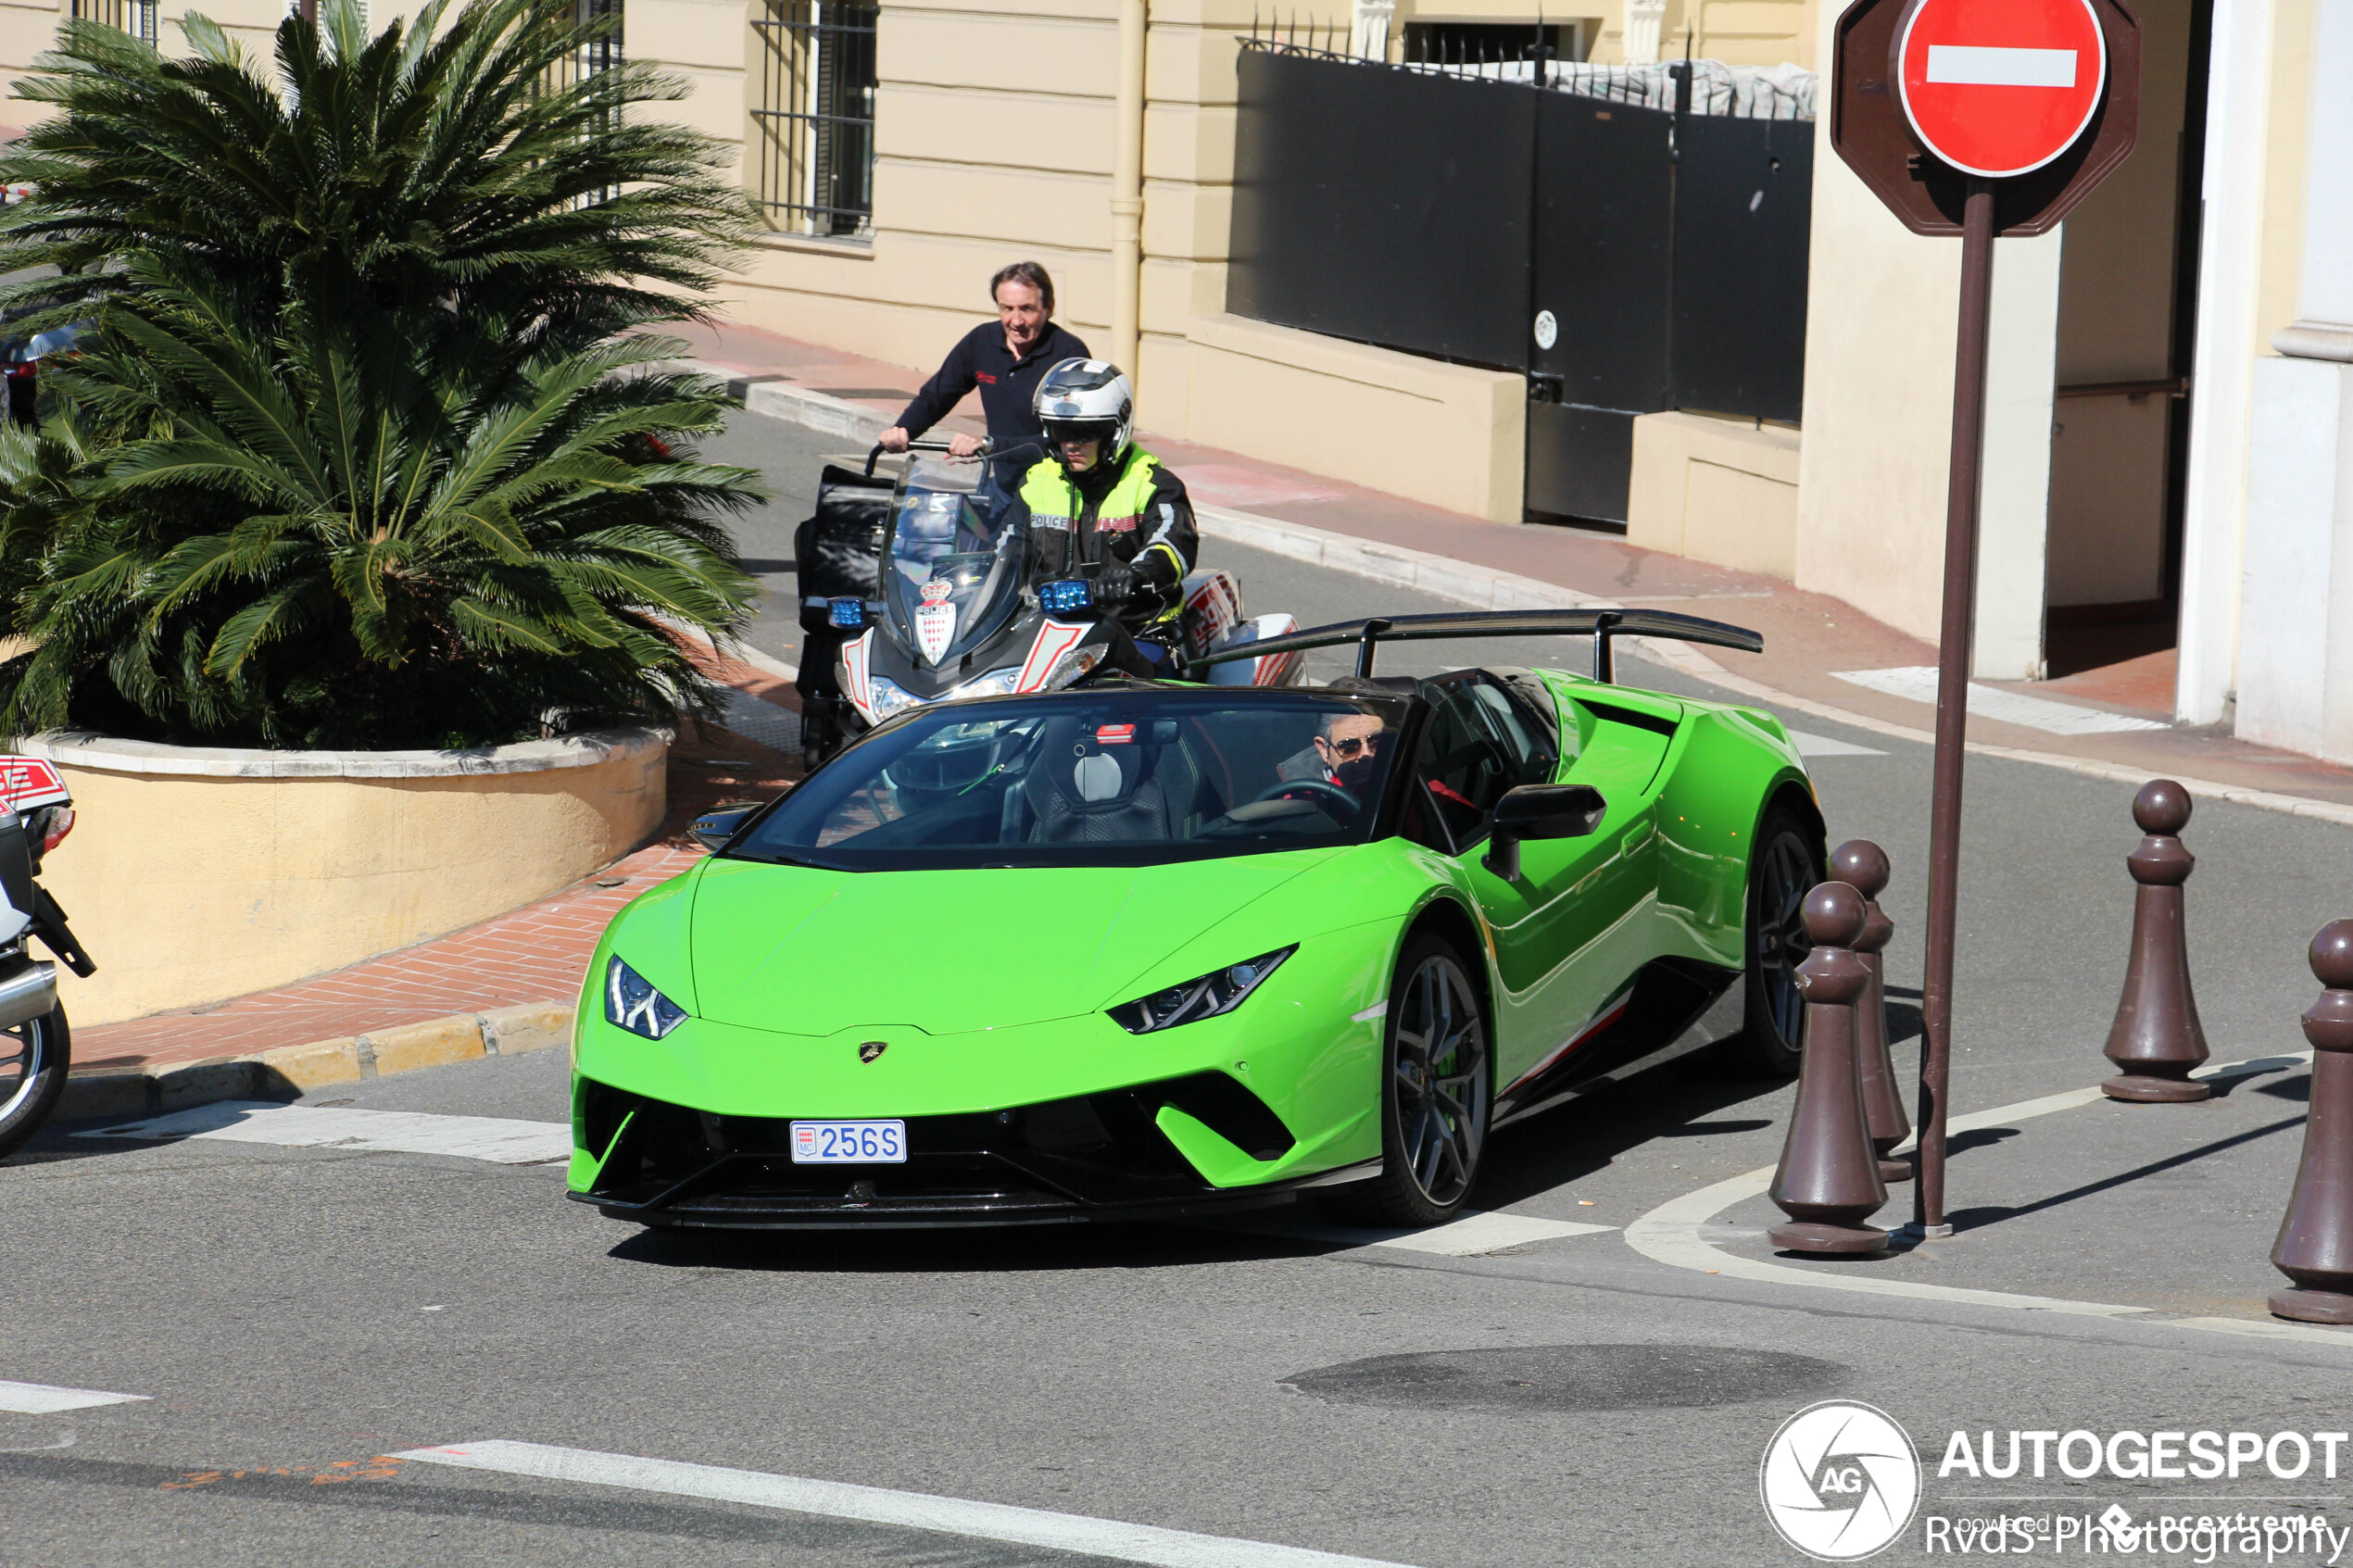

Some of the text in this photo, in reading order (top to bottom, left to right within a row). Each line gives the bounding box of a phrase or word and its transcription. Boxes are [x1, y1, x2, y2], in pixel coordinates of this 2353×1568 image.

[1031, 515, 1066, 527] POLICE
[799, 1143, 812, 1152] MC
[821, 1127, 899, 1157] 256S
